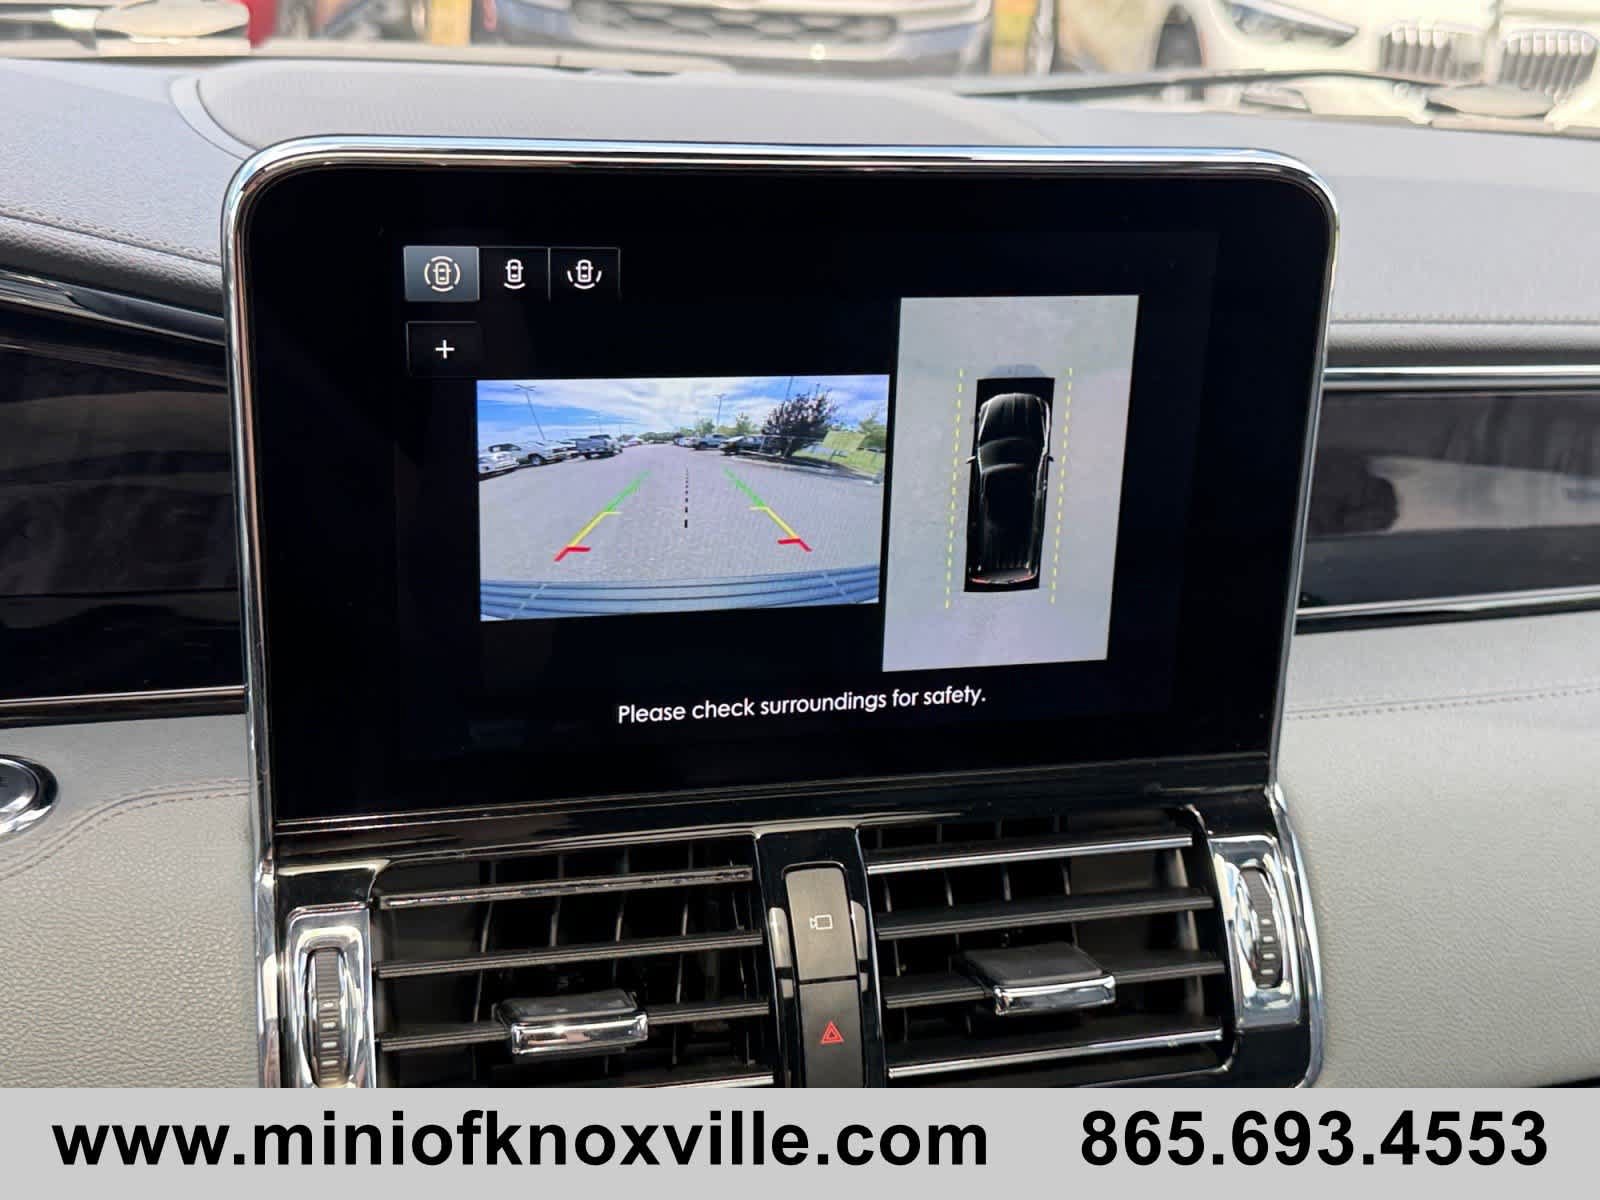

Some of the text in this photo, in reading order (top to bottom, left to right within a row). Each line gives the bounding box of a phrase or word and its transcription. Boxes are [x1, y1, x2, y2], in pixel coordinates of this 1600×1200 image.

[618, 685, 986, 724] Please check surroundings for safety.
